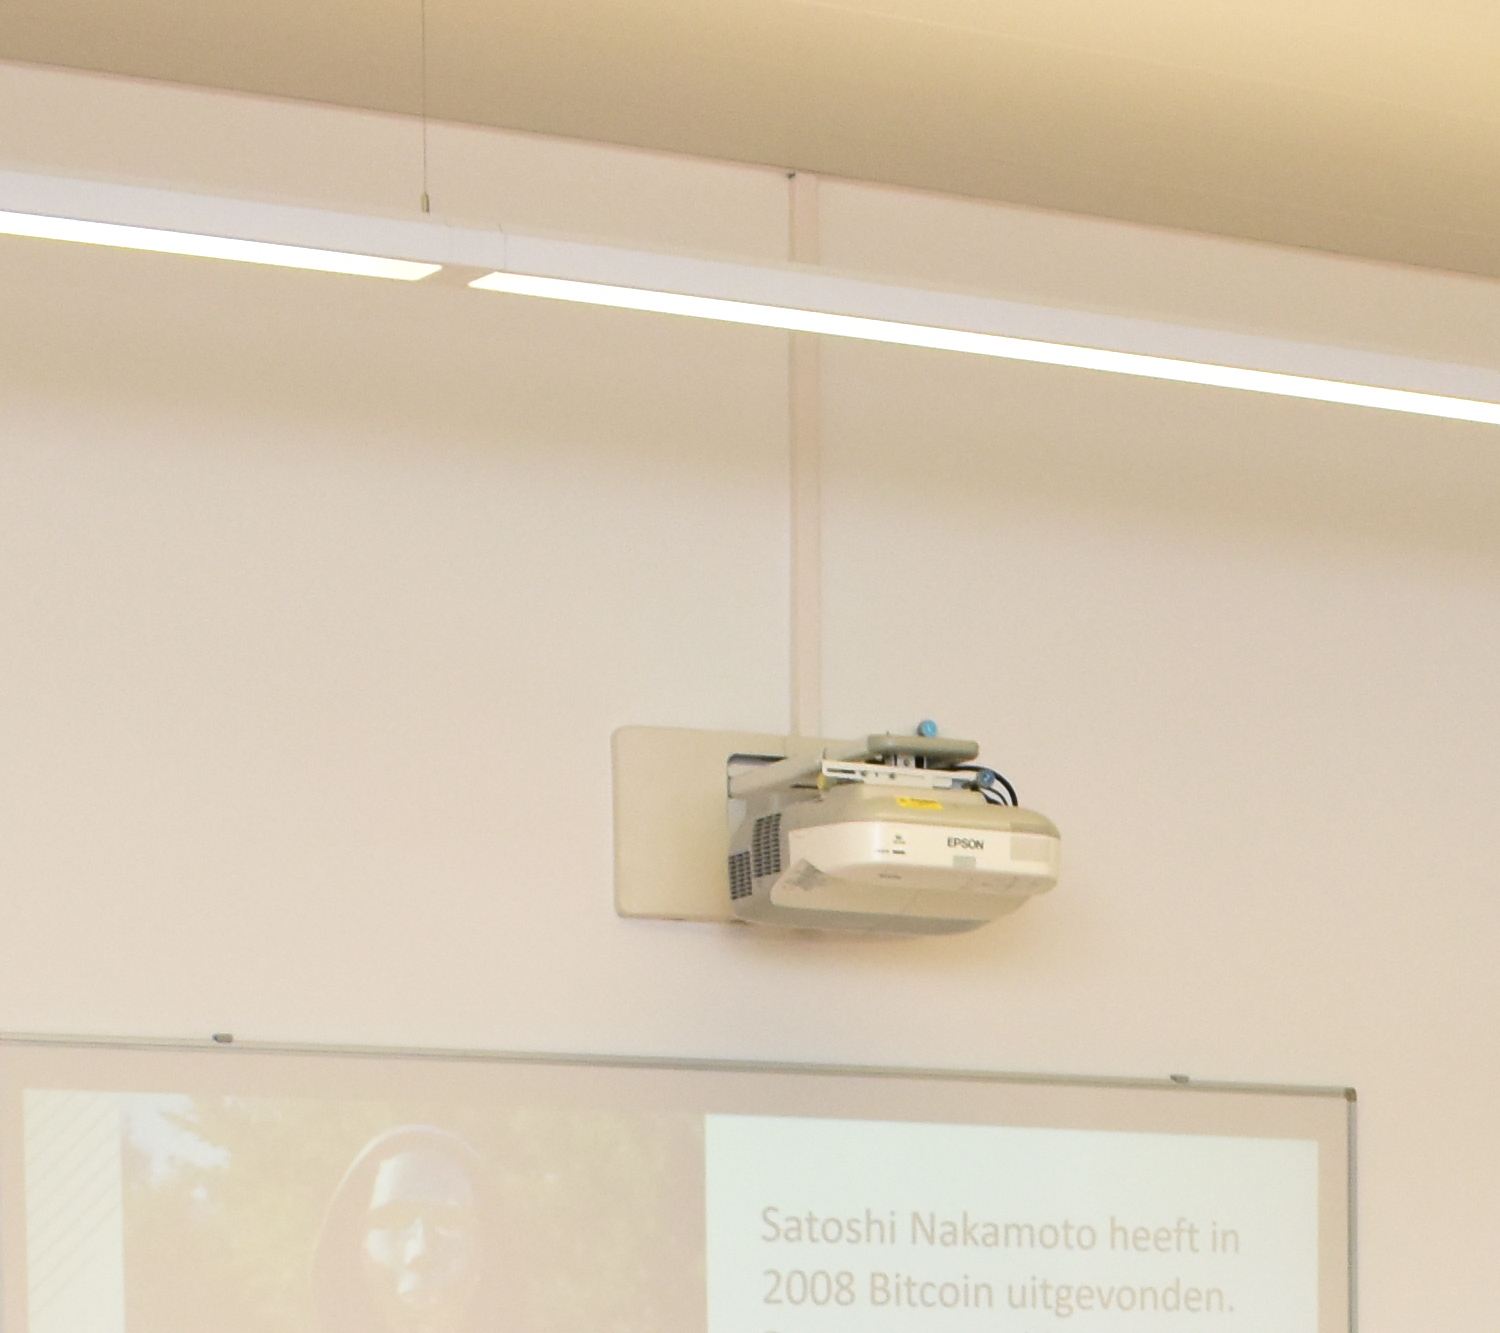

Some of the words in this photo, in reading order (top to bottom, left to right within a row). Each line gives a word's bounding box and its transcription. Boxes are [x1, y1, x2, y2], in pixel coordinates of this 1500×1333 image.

[947, 836, 984, 850] EPSON
[761, 1206, 896, 1244] Satoshi
[911, 1210, 1097, 1250] Nakamoto
[1110, 1215, 1200, 1252] heeft
[1212, 1221, 1240, 1254] in
[763, 1268, 855, 1306] 2008
[870, 1272, 993, 1308] Bitcoin
[1007, 1275, 1234, 1318] uitgevonden.
